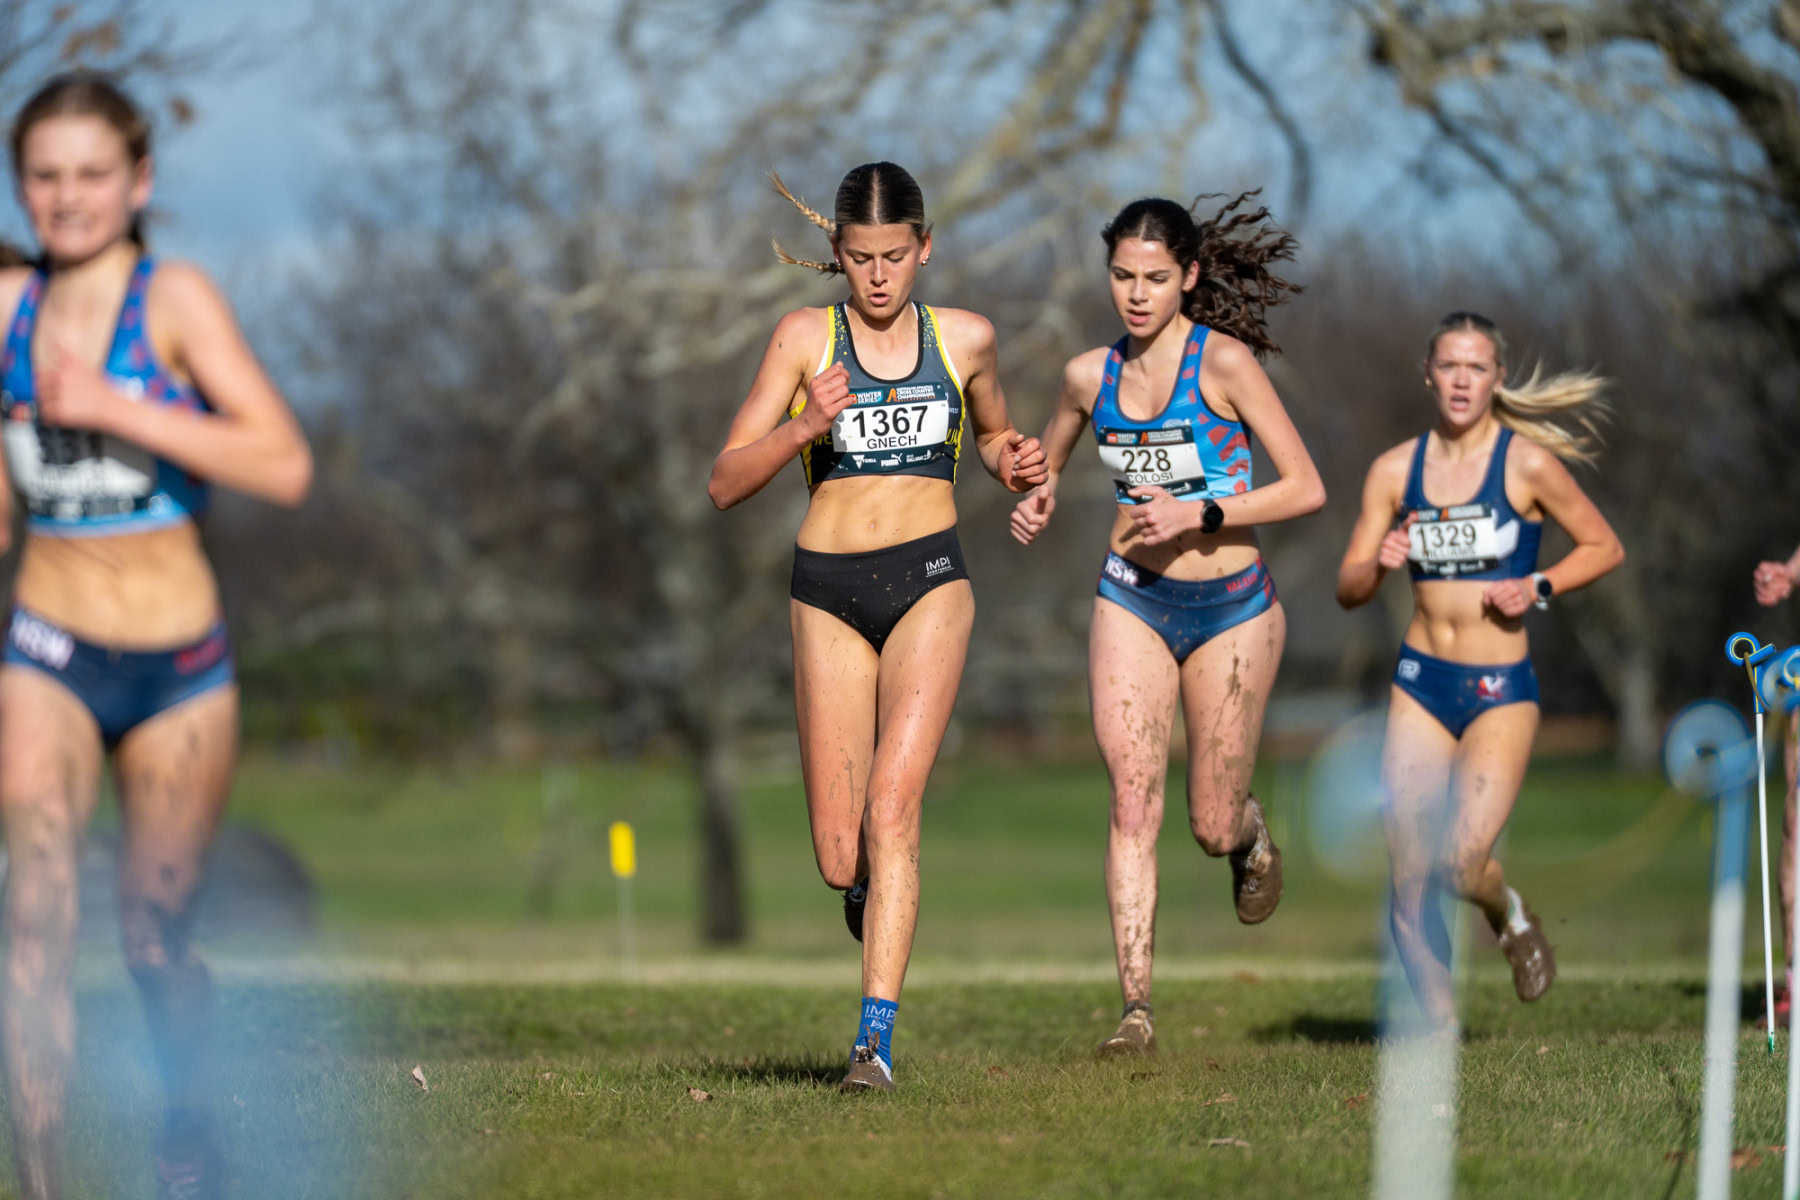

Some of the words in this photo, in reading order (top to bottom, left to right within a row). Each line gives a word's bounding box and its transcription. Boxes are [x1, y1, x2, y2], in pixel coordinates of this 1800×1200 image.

[857, 391, 882, 399] WINTER
[852, 405, 928, 438] 1367
[866, 434, 917, 449] GNECH
[1121, 448, 1172, 473] 228
[1127, 472, 1174, 484] COLOSI
[1416, 523, 1476, 557] 1329
[925, 556, 951, 571] IMPI
[1105, 558, 1138, 585] NSW
